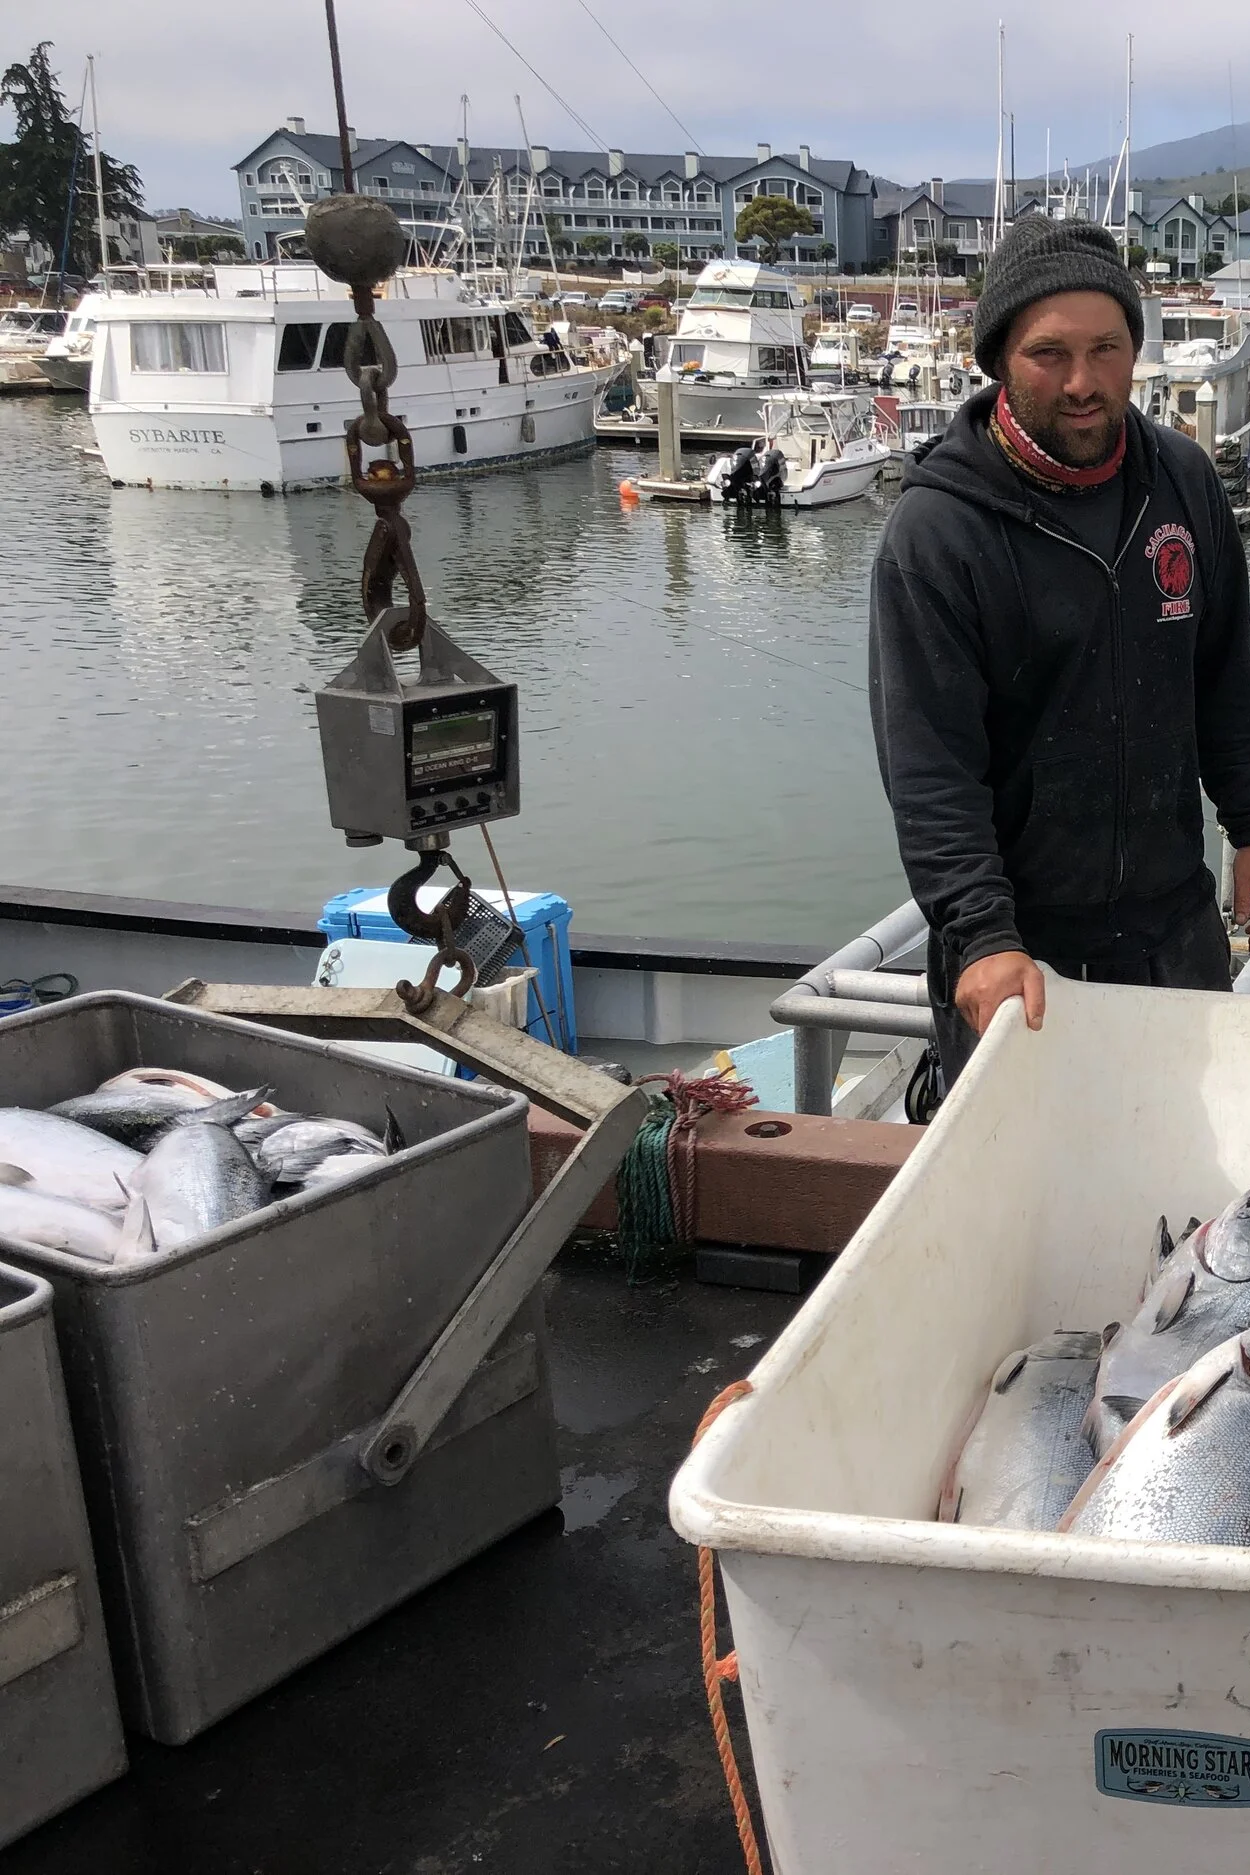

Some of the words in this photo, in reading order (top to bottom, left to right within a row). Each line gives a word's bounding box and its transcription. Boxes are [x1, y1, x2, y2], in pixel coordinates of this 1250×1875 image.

[129, 429, 226, 444] SYBARITE
[1161, 599, 1191, 617] FIRE
[424, 762, 448, 773] OCEAN
[1110, 1739, 1199, 1774] MORNING
[1133, 1766, 1178, 1778] FISHERIES
[1180, 1770, 1186, 1779] &
[1189, 1772, 1231, 1782] SEAFOOD
